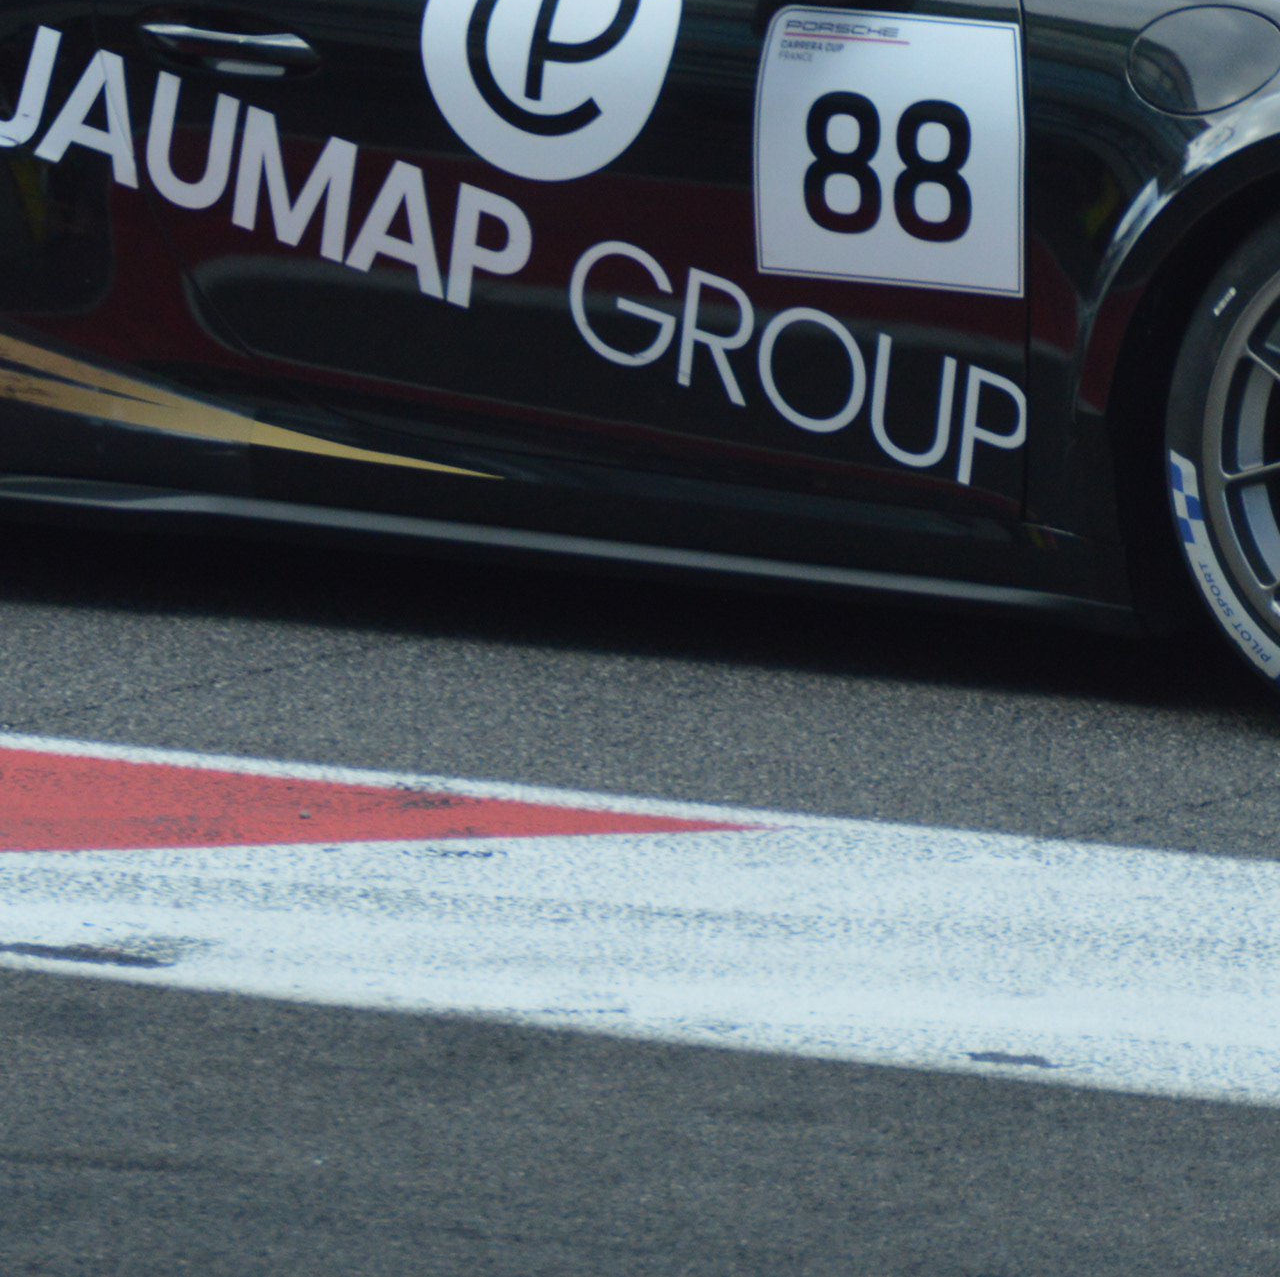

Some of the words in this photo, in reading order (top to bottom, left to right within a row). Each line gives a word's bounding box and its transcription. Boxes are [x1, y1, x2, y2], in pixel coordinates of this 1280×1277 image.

[780, 39, 823, 52] CARRERA
[825, 43, 845, 53] CUP
[786, 20, 899, 38] PORSCHE
[778, 50, 813, 62] FRANCE
[803, 90, 973, 243] 88
[569, 240, 1027, 486] GROUP
[1198, 561, 1234, 617] SPORT
[1232, 622, 1271, 663] PILOT
